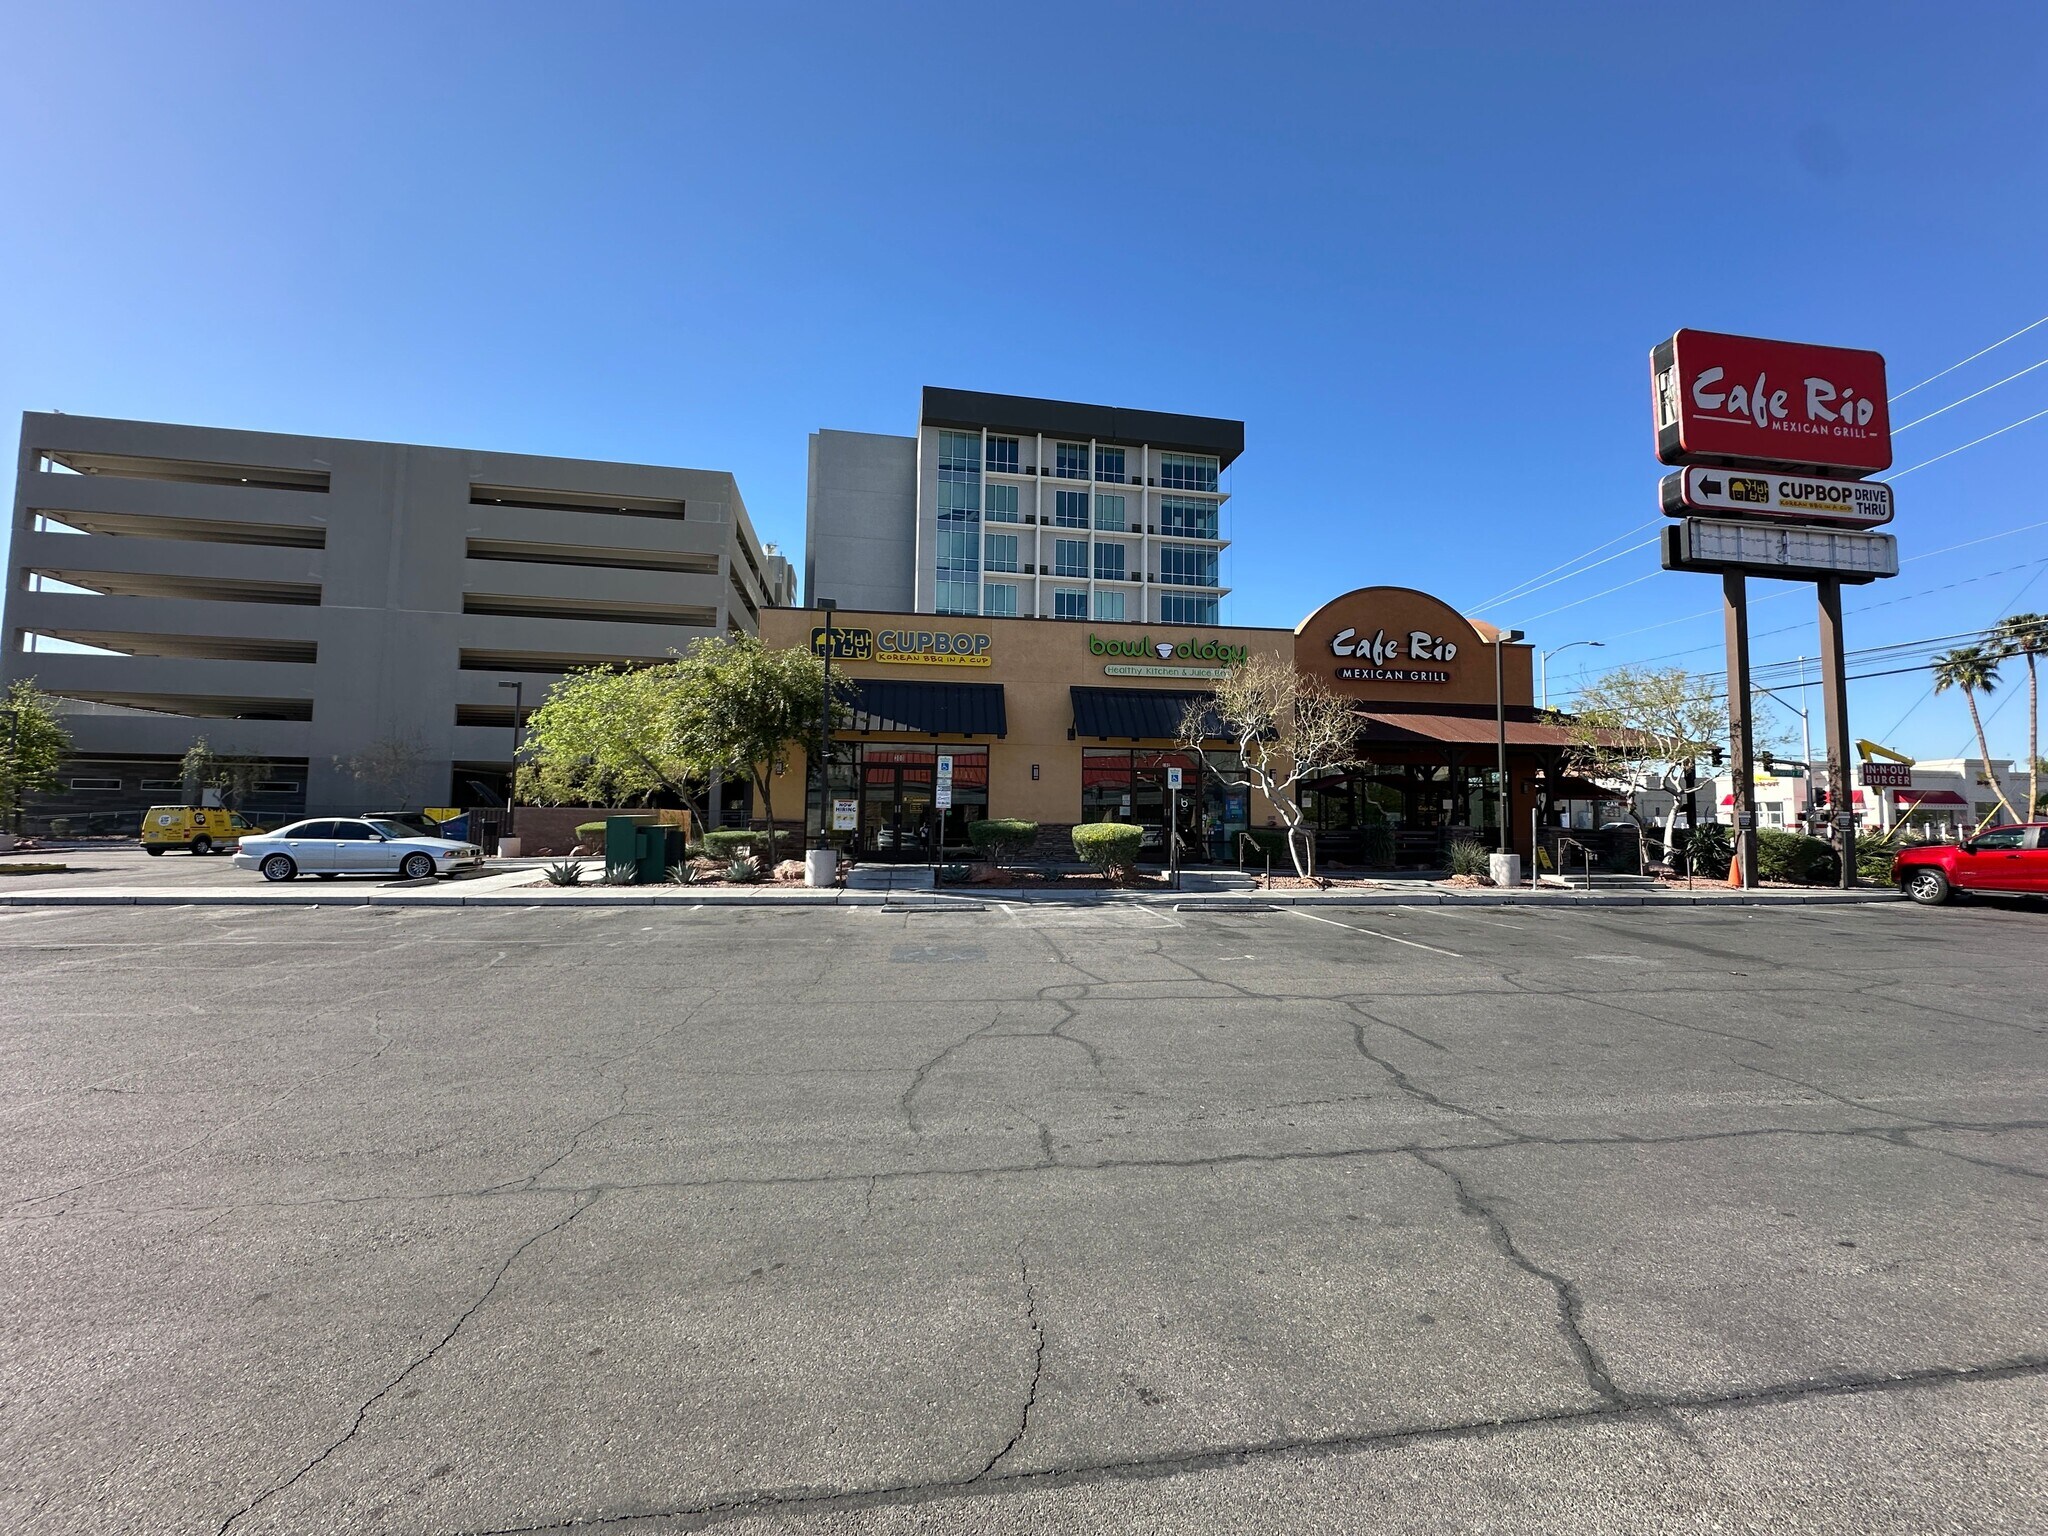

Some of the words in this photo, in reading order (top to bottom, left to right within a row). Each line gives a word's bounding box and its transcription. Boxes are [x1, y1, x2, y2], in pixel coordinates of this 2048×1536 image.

[1692, 366, 1789, 428] Cafe
[1772, 421, 1829, 436] MEXICAN
[1833, 426, 1867, 439] GRILL
[1778, 481, 1853, 503] CUPBOP
[1855, 488, 1887, 502] DRIVE
[1779, 499, 1806, 508] KOREAN
[1856, 502, 1886, 516] THRU
[876, 629, 991, 656] CUPBOP
[1089, 632, 1155, 658] bowl
[1331, 627, 1398, 666] Cafe
[1409, 630, 1457, 662] Rio
[878, 653, 919, 662] KOREAN
[923, 655, 943, 663] BBQ
[1107, 666, 1143, 675] Healthy
[1146, 667, 1179, 676] Kitchen
[1189, 669, 1212, 677] Juice
[1342, 668, 1403, 680] MEXICAN
[1410, 671, 1446, 682] GRILL
[1866, 775, 1910, 785] BURGER
